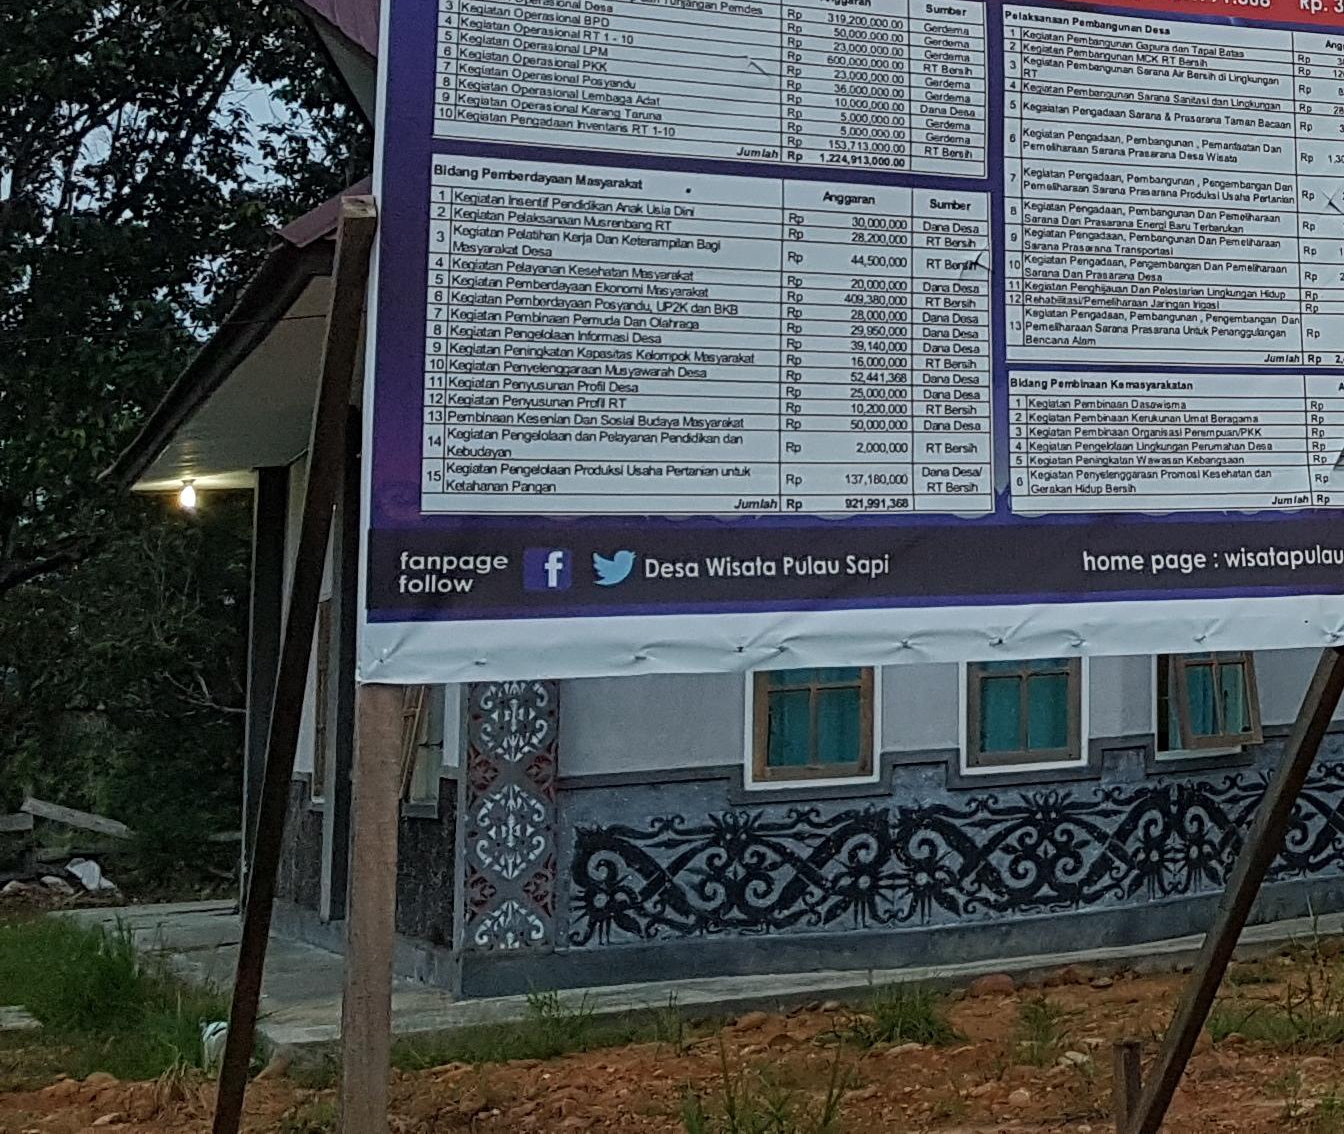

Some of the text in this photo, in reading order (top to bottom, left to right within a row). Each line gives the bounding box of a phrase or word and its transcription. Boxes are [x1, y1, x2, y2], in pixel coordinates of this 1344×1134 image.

[925, 3, 967, 17] Sumber
[1005, 10, 1170, 36] Pelaksanaan Pembangunan Desa
[736, 147, 803, 162] Jumlah Rp
[433, 163, 643, 190] Bidang Pemberdayaan Masyarakat
[822, 191, 875, 205] Anggaran
[929, 198, 972, 211] Sumber
[1010, 377, 1193, 392] Bidang Pembinaan Kemasyarakatan
[512, 482, 556, 494] Pangan
[399, 550, 509, 575] fanpage
[644, 553, 889, 578] Desa Wisata Pulau Sapi
[1082, 550, 1144, 571] home
[1151, 552, 1207, 574] page
[399, 573, 473, 595] follow
